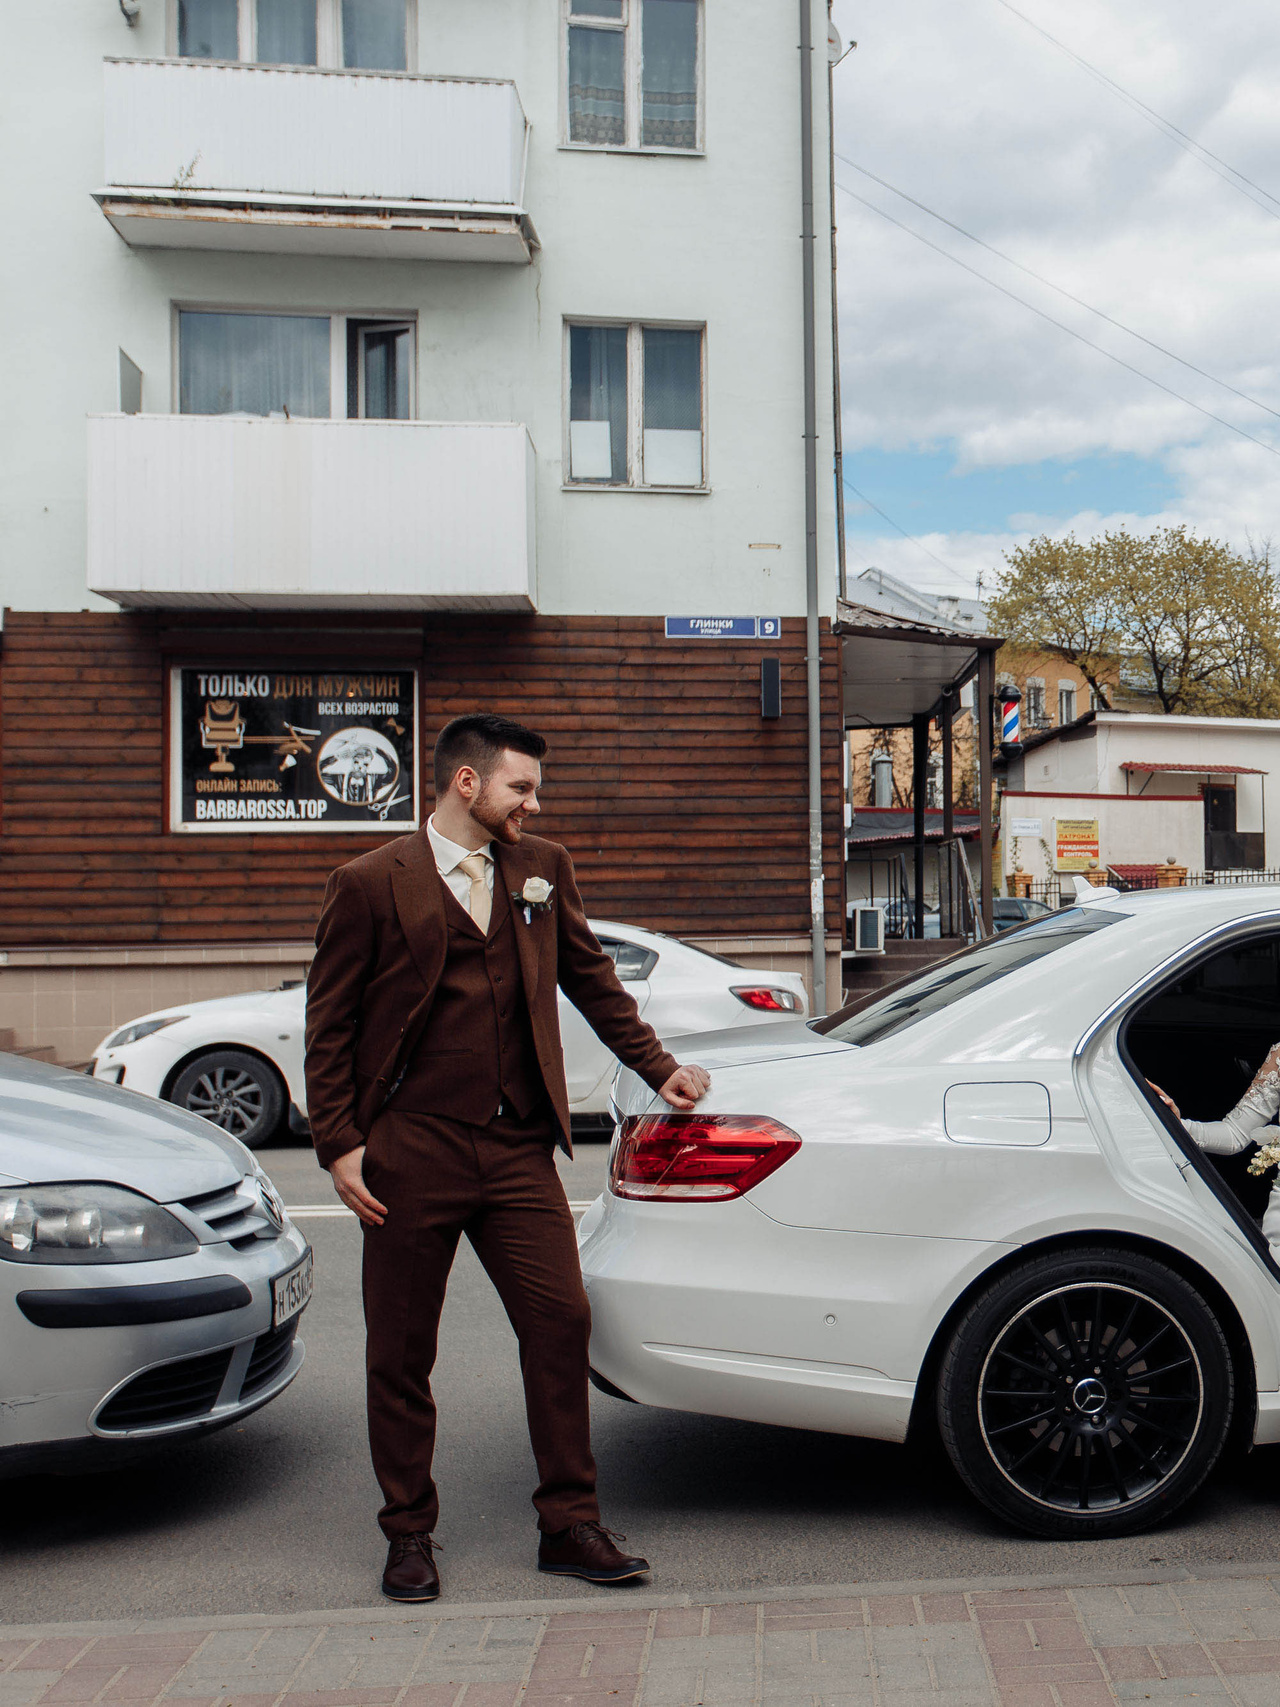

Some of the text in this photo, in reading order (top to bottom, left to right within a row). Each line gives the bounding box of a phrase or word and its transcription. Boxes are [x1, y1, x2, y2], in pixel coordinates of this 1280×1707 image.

[689, 619, 734, 629] ГЛИНКИ
[764, 621, 775, 634] 9
[198, 674, 401, 699] ТОЛЬКО ДЛЯ МУЖЧИН
[318, 702, 400, 716] ВСЕХ ВОЗРАСТОВ
[196, 776, 283, 793] ОНЛАЙН ЗАПИСЬ:
[196, 799, 328, 820] BARBAROSSA.TOP
